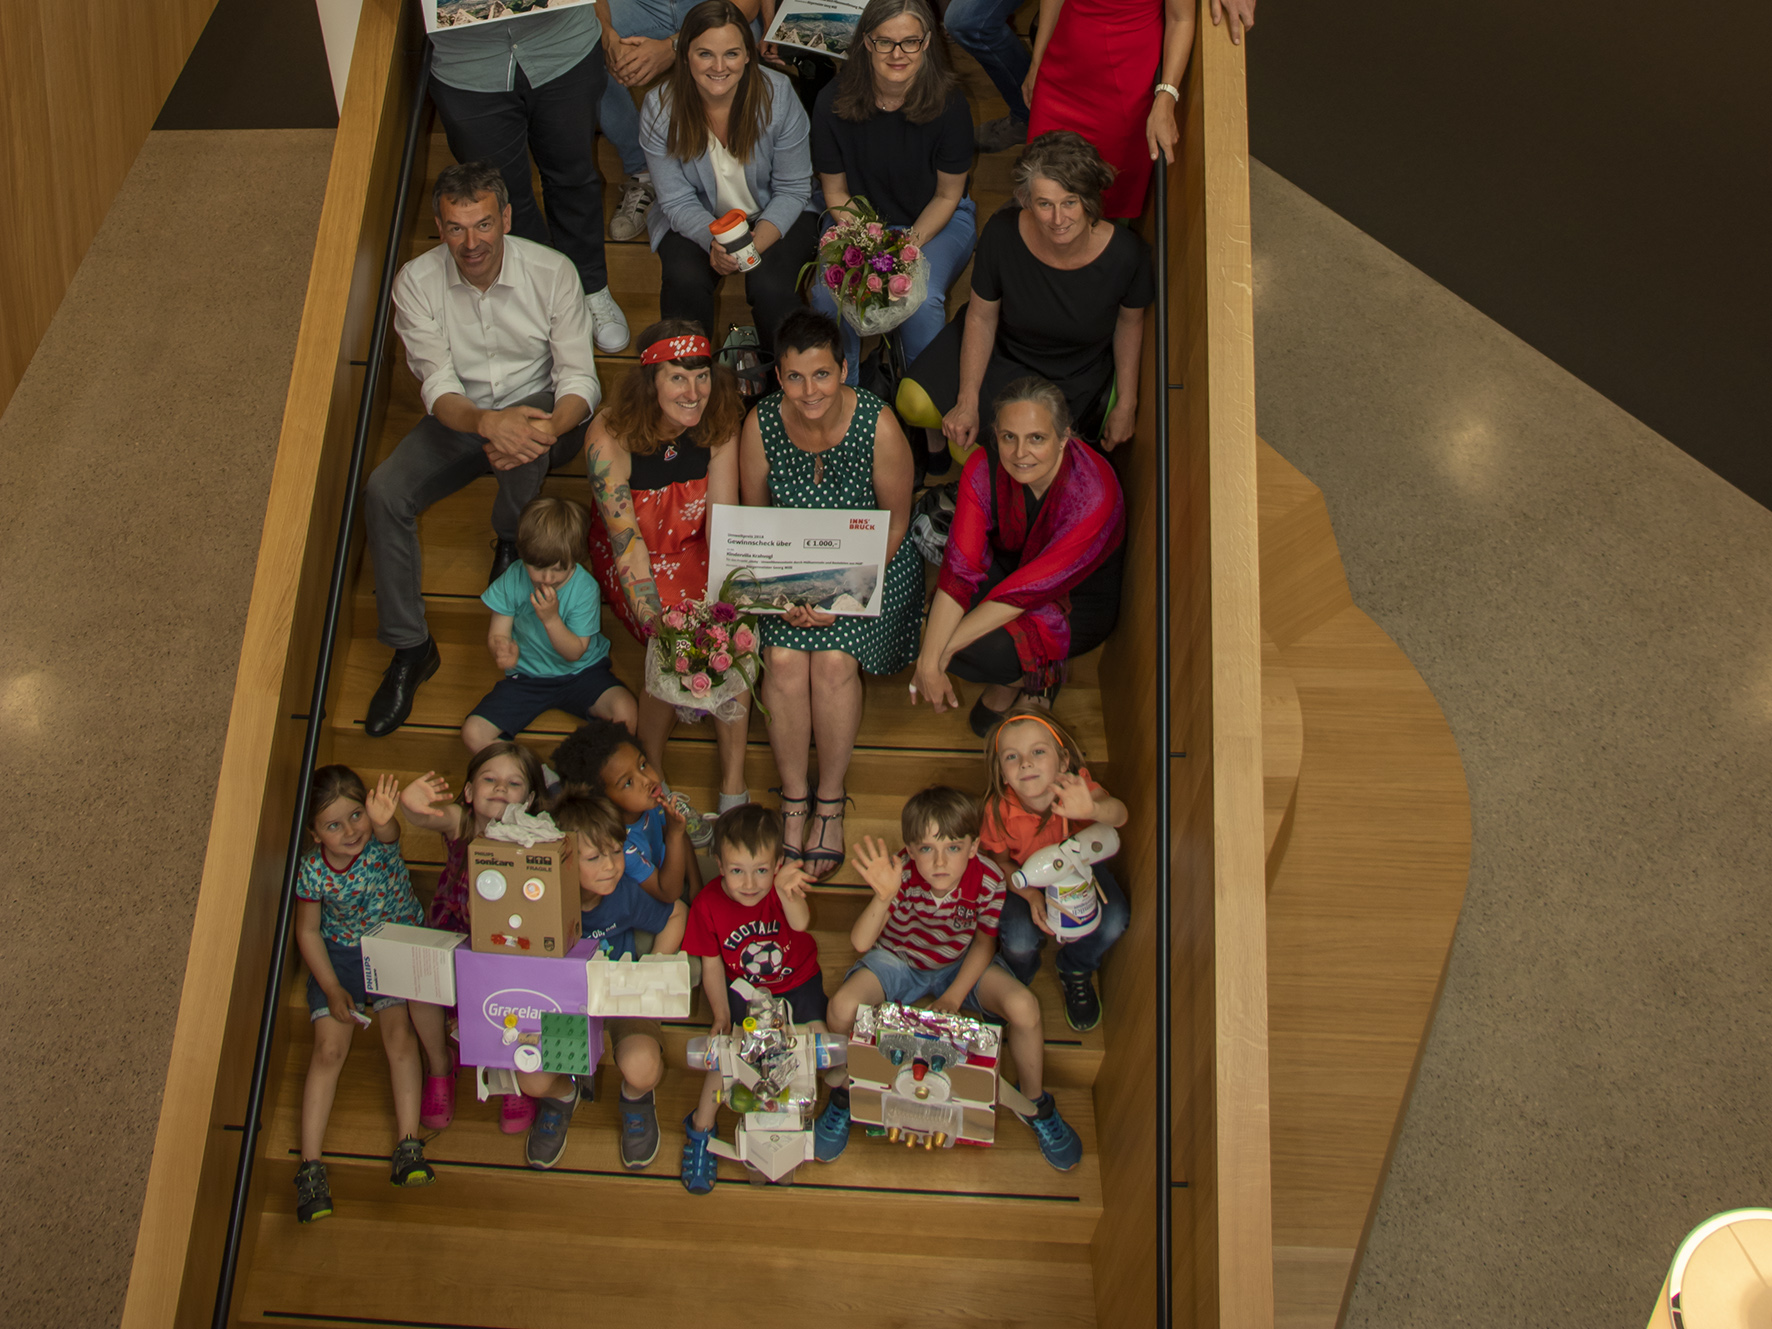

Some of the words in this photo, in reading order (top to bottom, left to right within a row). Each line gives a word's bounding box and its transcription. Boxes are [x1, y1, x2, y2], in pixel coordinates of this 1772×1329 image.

[727, 538, 775, 546] Gewinnscheck
[475, 857, 514, 867] sonicare
[363, 956, 374, 990] PHILIPS
